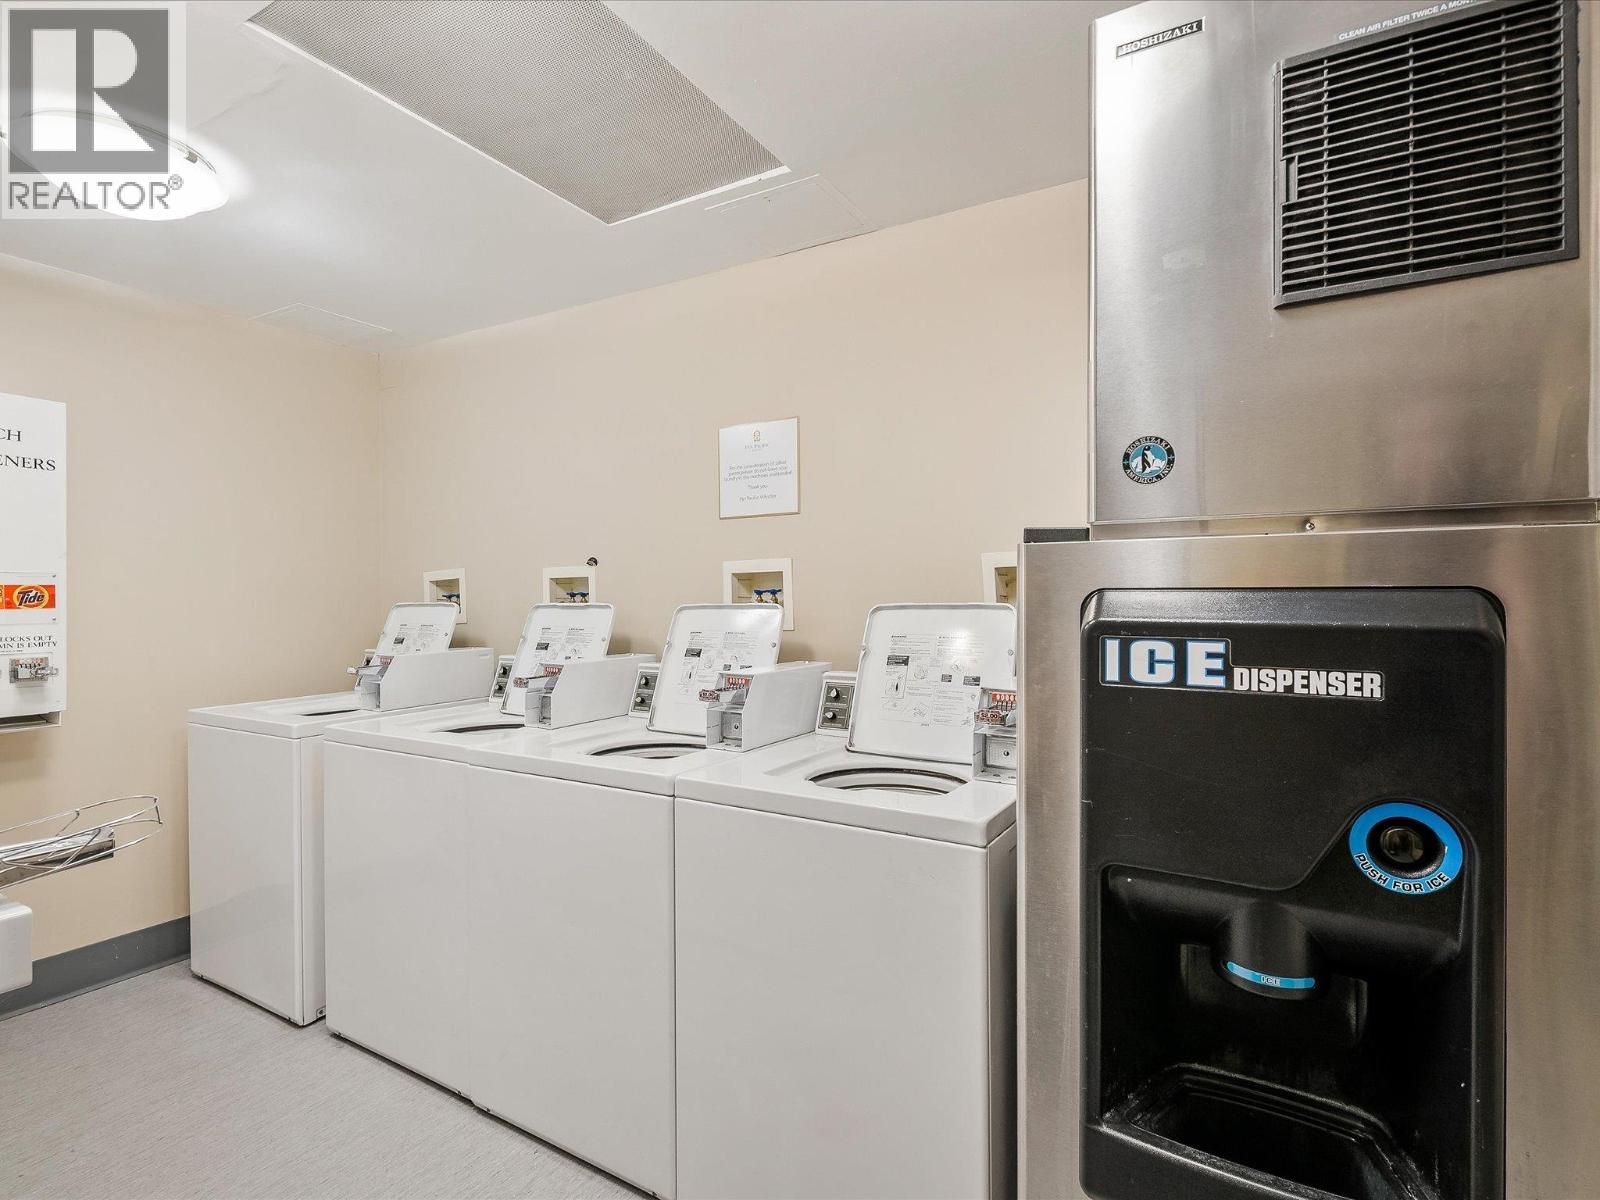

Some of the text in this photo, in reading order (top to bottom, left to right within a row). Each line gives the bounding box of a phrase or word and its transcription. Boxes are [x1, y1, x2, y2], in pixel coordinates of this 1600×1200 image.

[1121, 21, 1199, 55] HOSHIZAKI
[1339, 27, 1365, 41] CLEAN
[1367, 22, 1381, 33] AIR
[1382, 14, 1410, 28] FILTER
[1411, 5, 1439, 19] TWICE
[1440, 3, 1448, 11] A
[1125, 436, 1171, 454] HOSHIZAKI
[17, 589, 46, 607] Tide
[27, 640, 58, 648] EMPTY
[1104, 637, 1382, 698] ICE DISPENSER
[1355, 853, 1450, 893] PUSH FOR ICE
